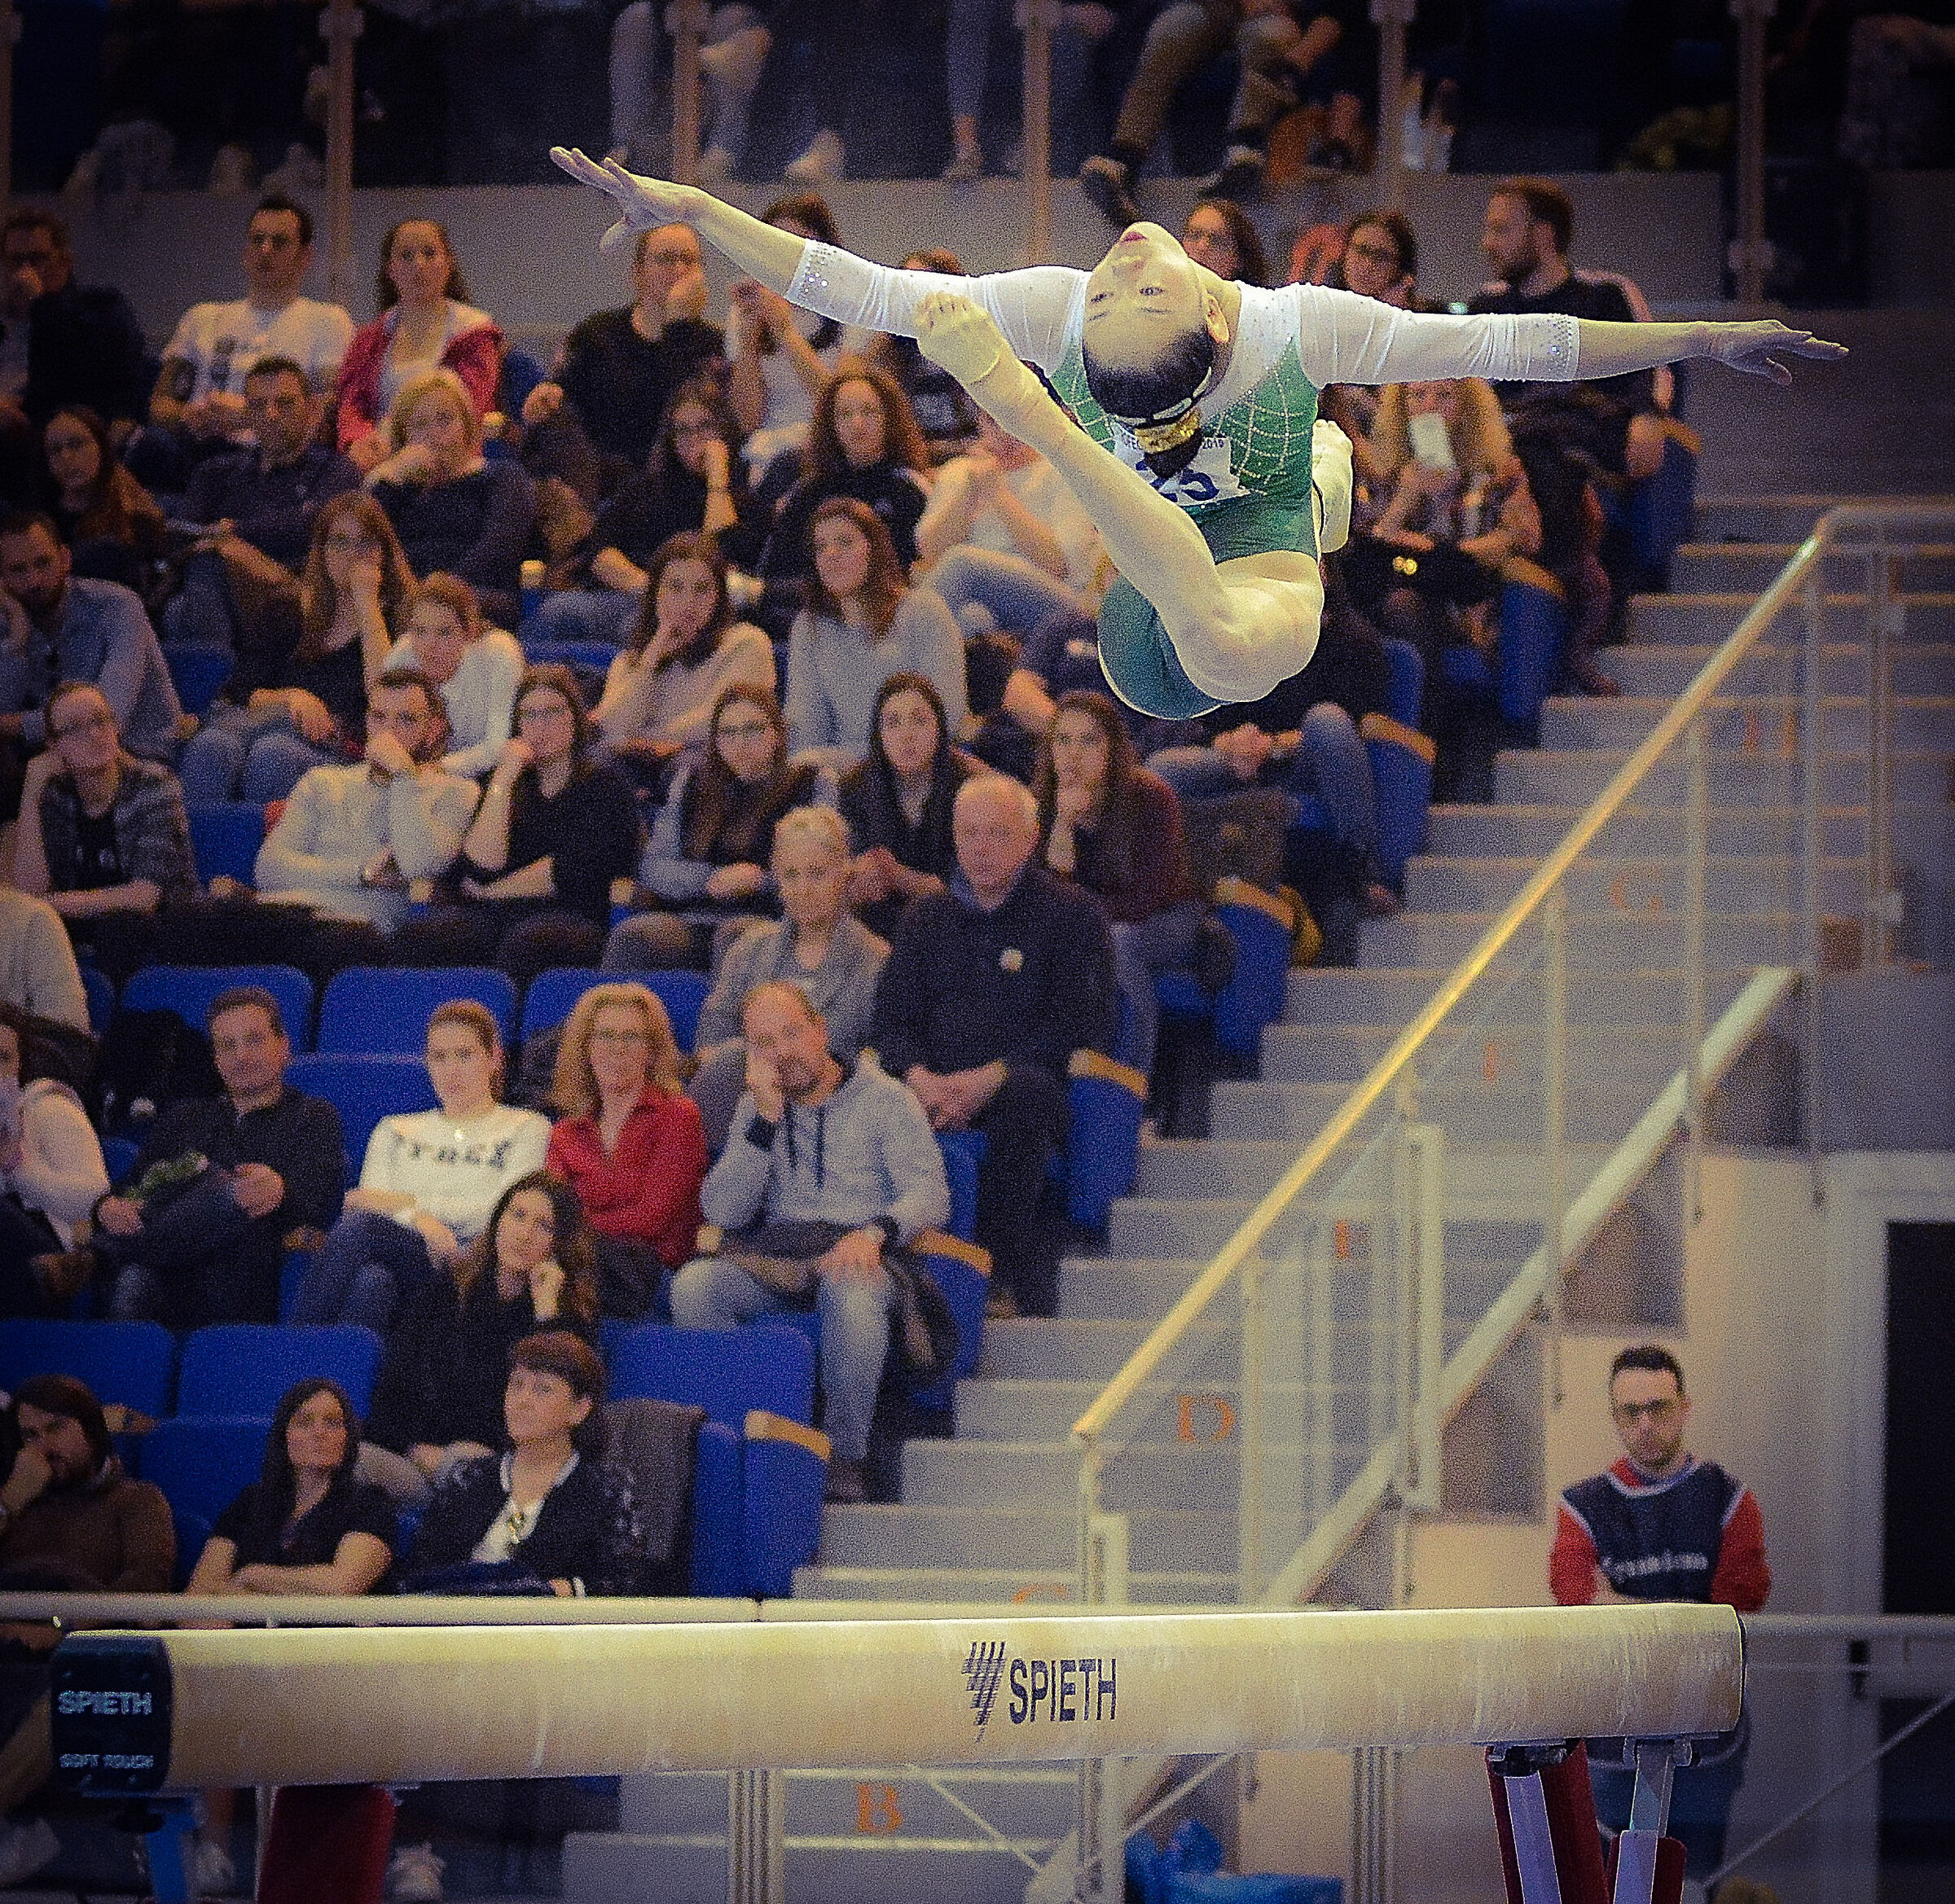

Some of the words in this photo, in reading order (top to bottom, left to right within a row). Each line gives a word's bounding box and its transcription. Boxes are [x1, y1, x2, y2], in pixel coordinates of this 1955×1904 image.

[1176, 1394, 1237, 1444] D
[58, 1690, 153, 1715] SPIETH
[1008, 1658, 1117, 1726] SPIETH
[855, 1783, 903, 1833] B
